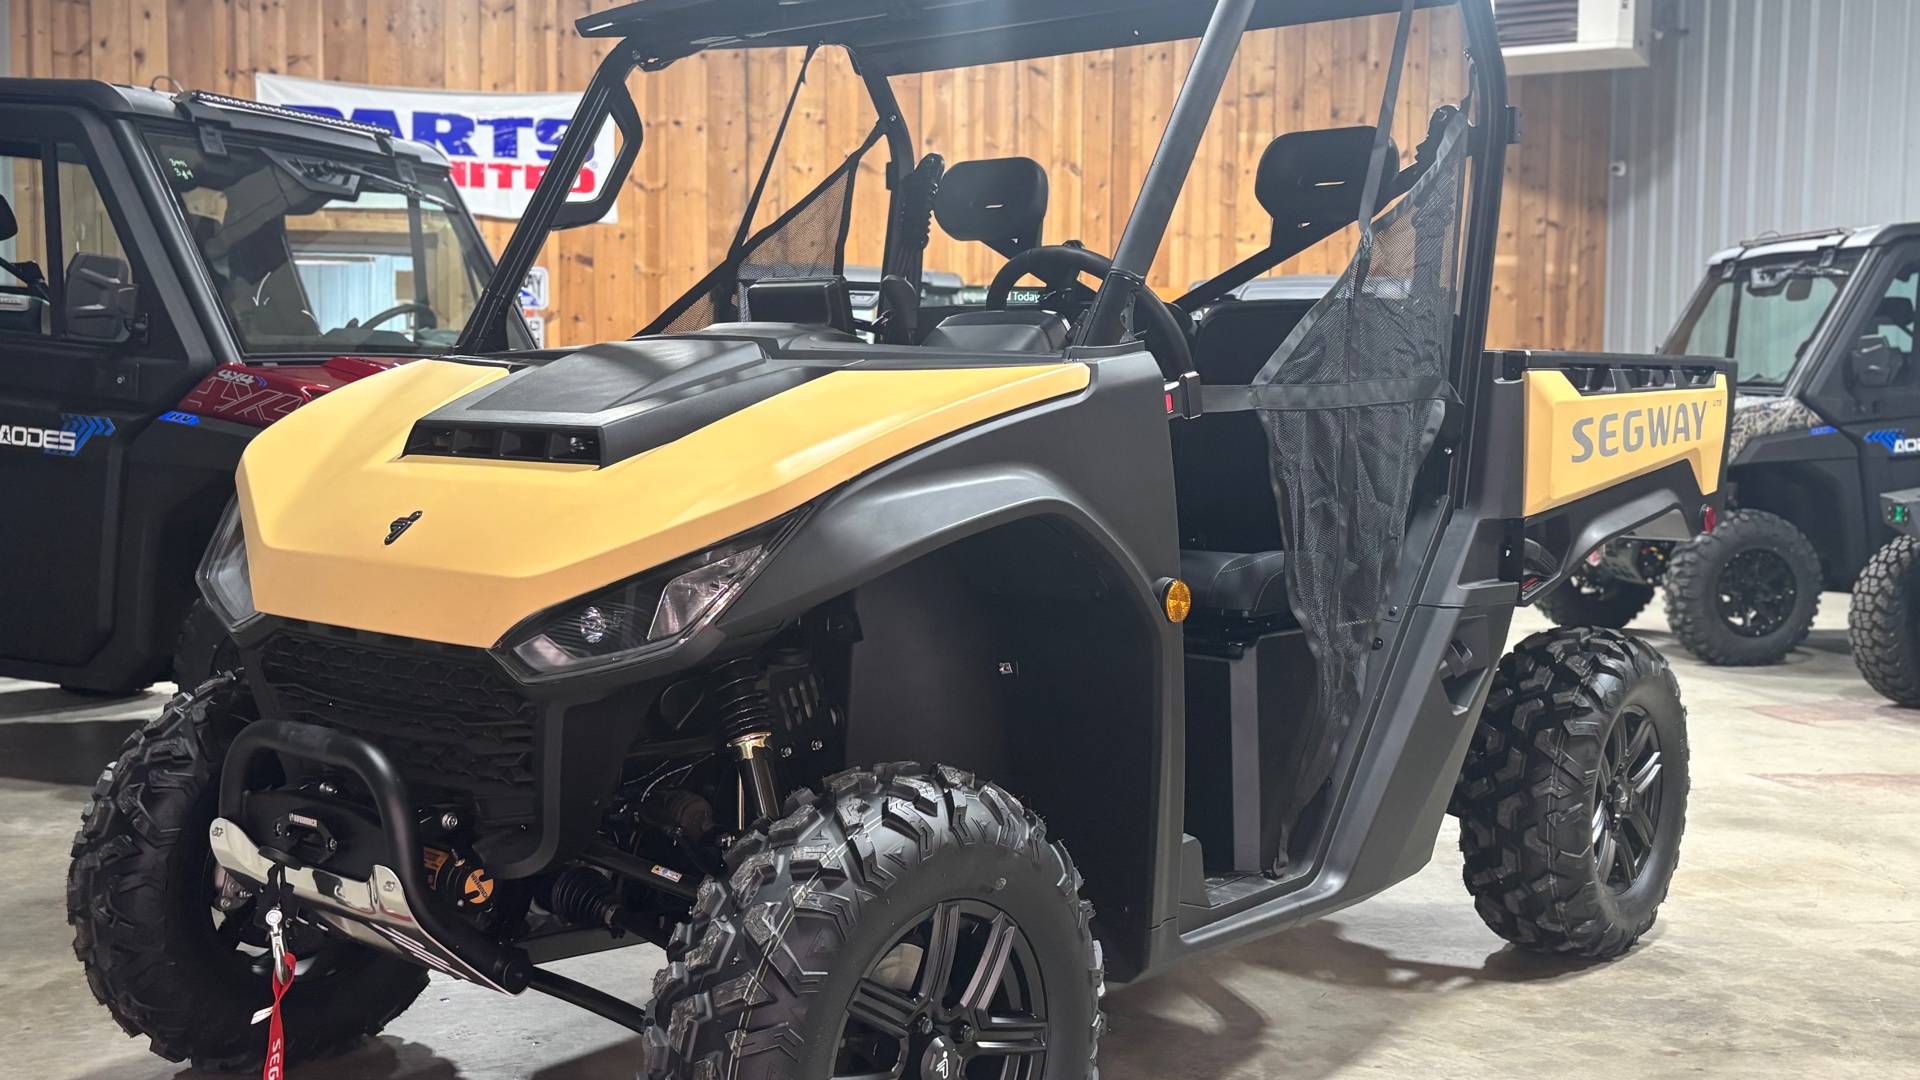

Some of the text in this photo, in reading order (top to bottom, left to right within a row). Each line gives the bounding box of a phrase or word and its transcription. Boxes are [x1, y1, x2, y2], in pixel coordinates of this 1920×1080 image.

[1012, 290, 1040, 304] Today
[0, 425, 76, 451] AODES
[1571, 400, 1707, 463] SEGWAY
